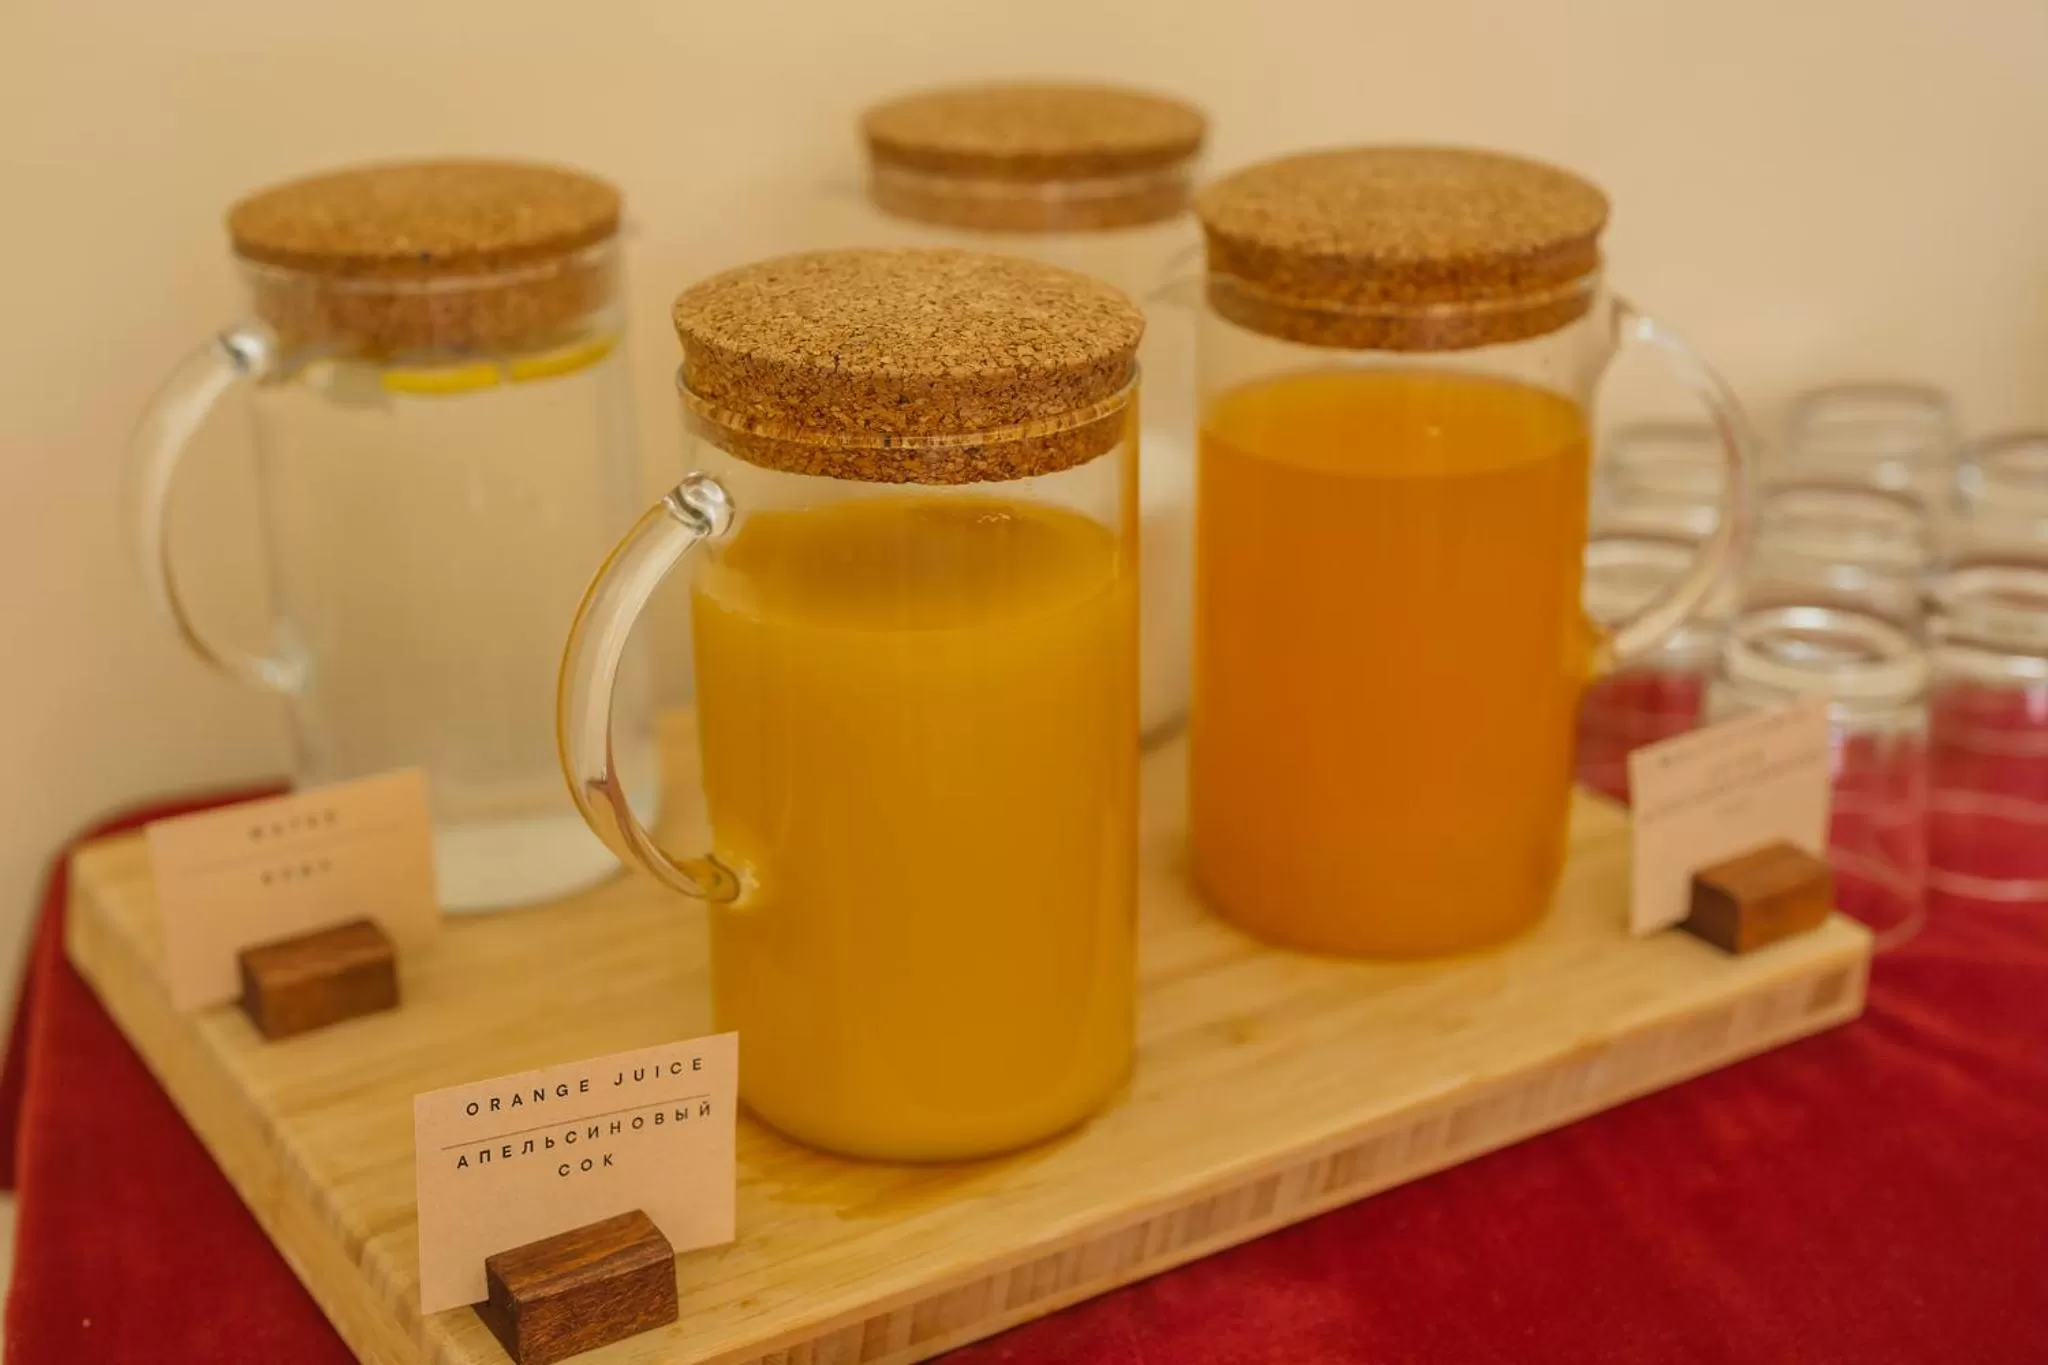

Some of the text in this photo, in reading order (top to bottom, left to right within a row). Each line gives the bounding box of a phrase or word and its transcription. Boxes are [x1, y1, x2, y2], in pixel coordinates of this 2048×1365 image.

[466, 1058, 703, 1117] ORANGE JUICE
[456, 1101, 711, 1170] АПЕЛЬСИНОВЫЙ
[558, 1152, 614, 1178] СОК
